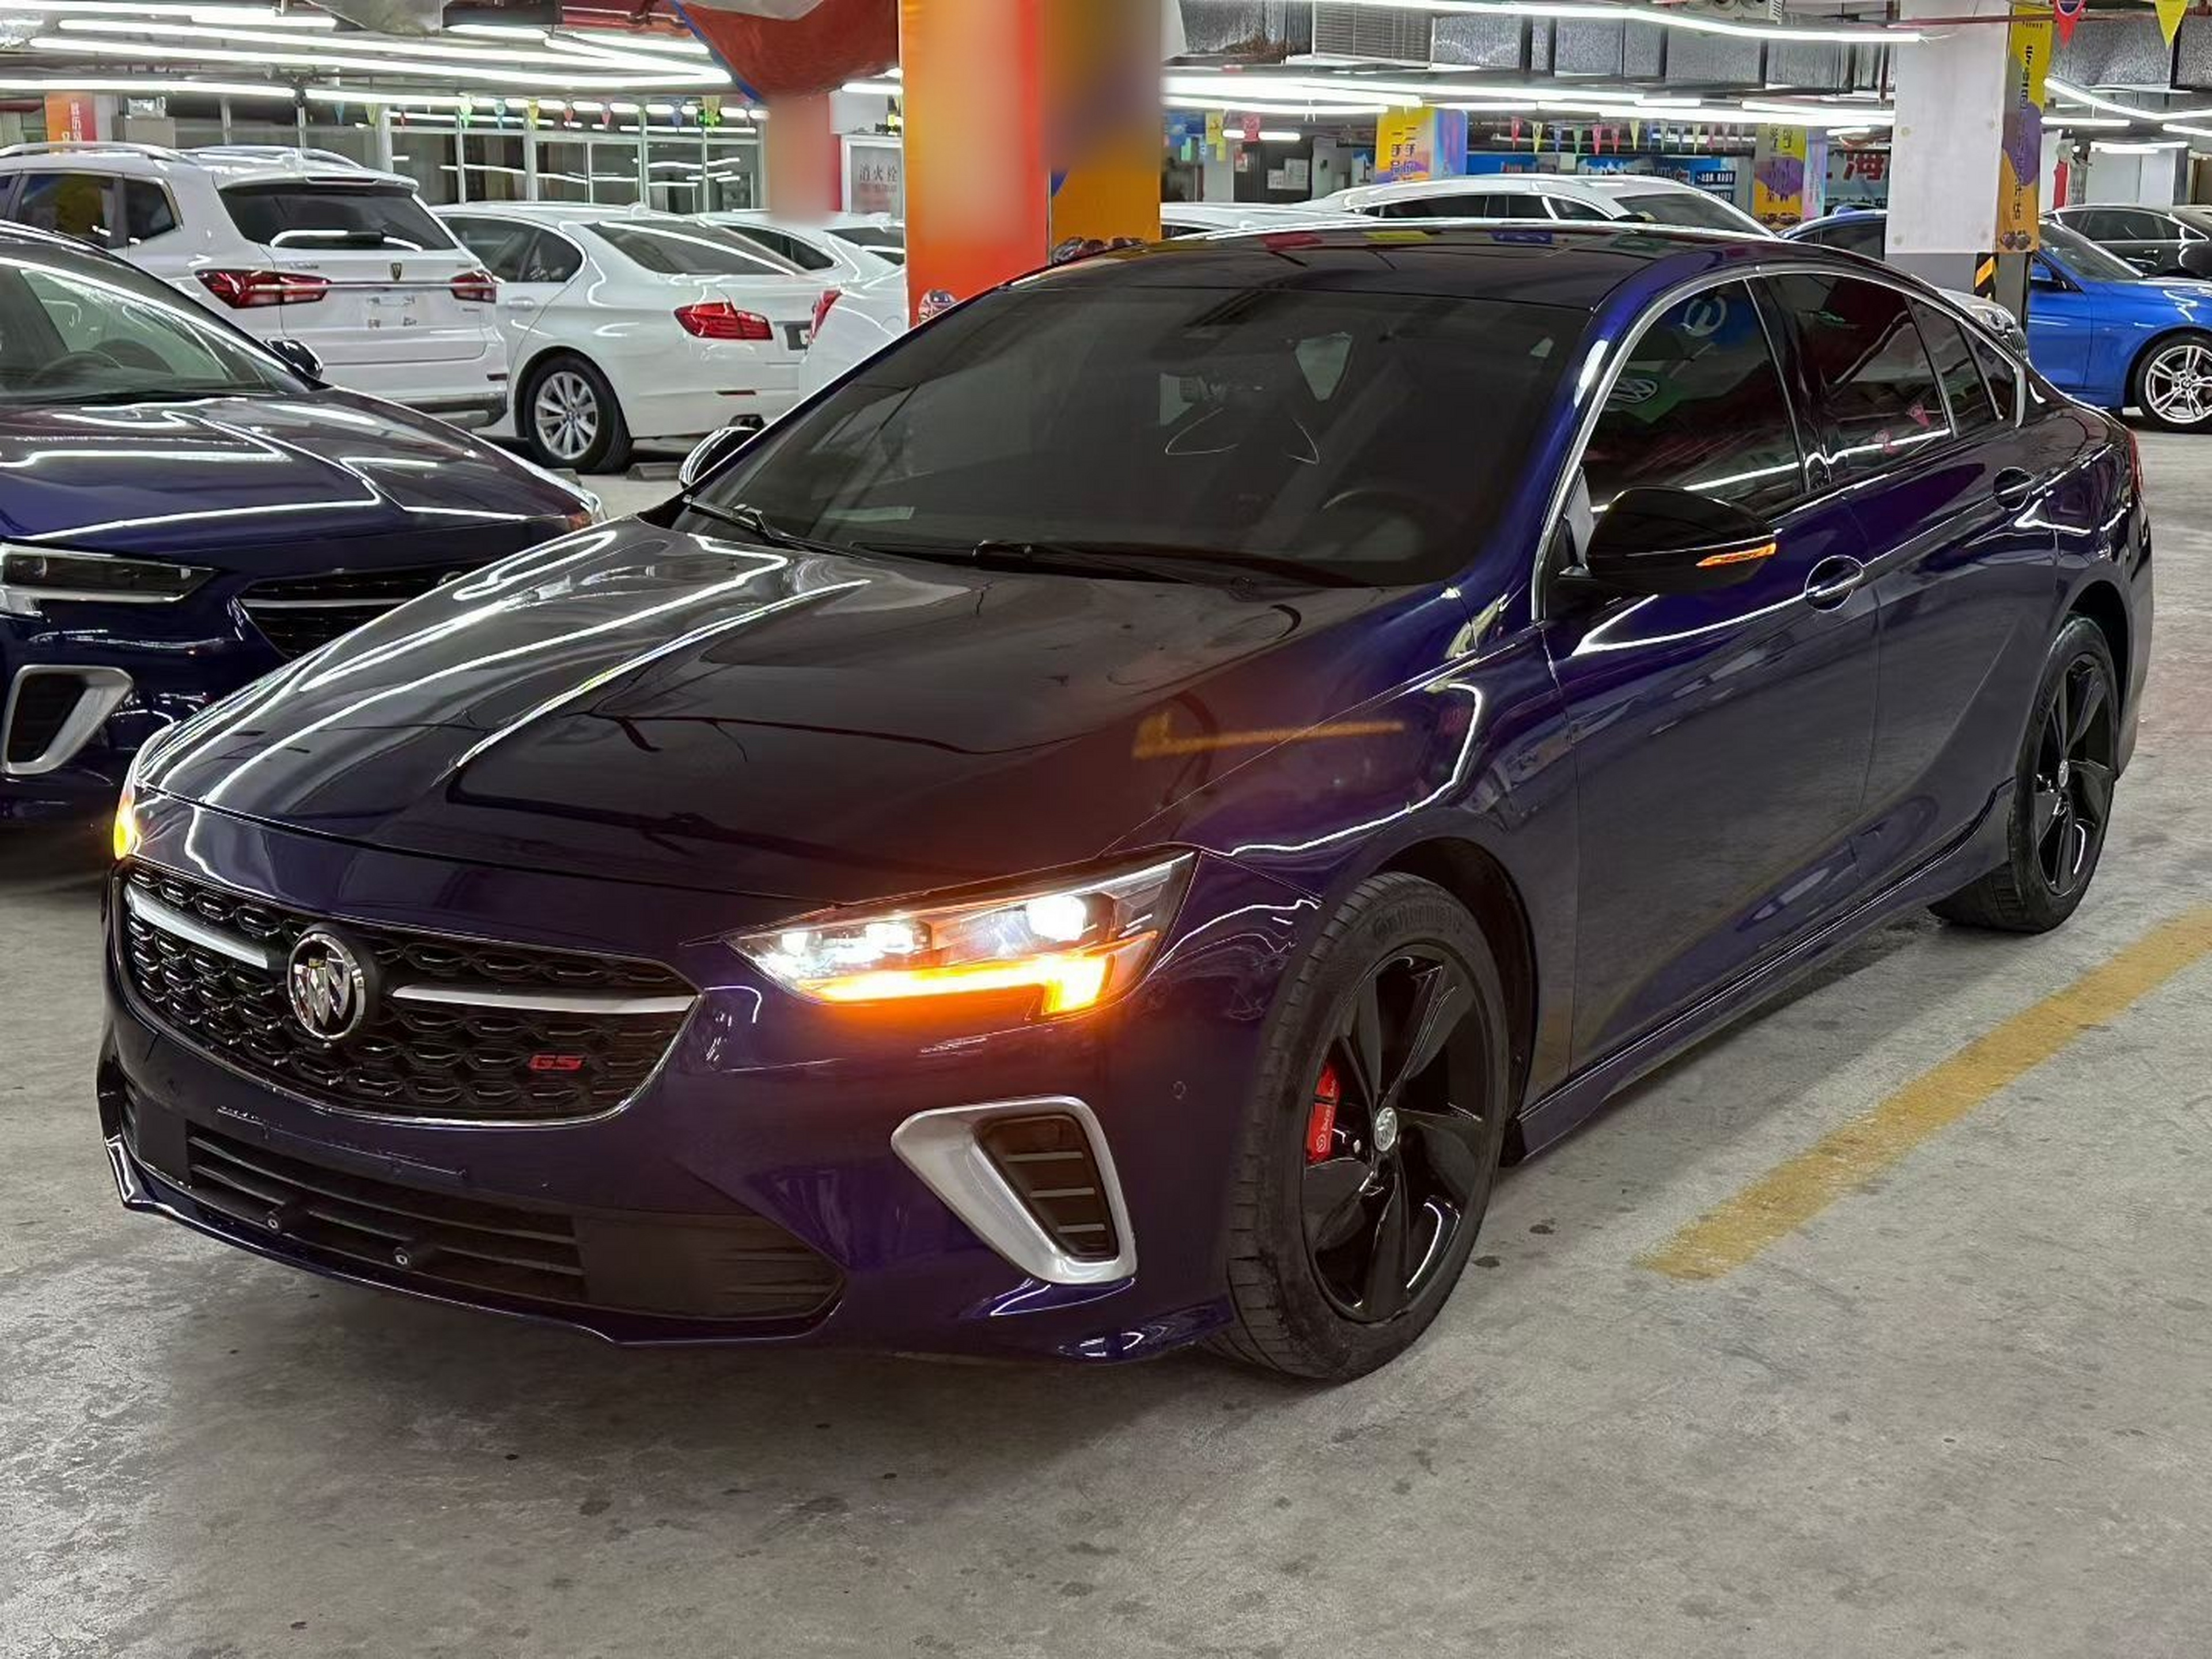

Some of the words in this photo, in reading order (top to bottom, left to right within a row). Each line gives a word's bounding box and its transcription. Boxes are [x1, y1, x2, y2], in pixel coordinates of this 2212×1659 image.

[859, 164, 897, 182] 消火栓
[529, 1054, 585, 1071] GS
